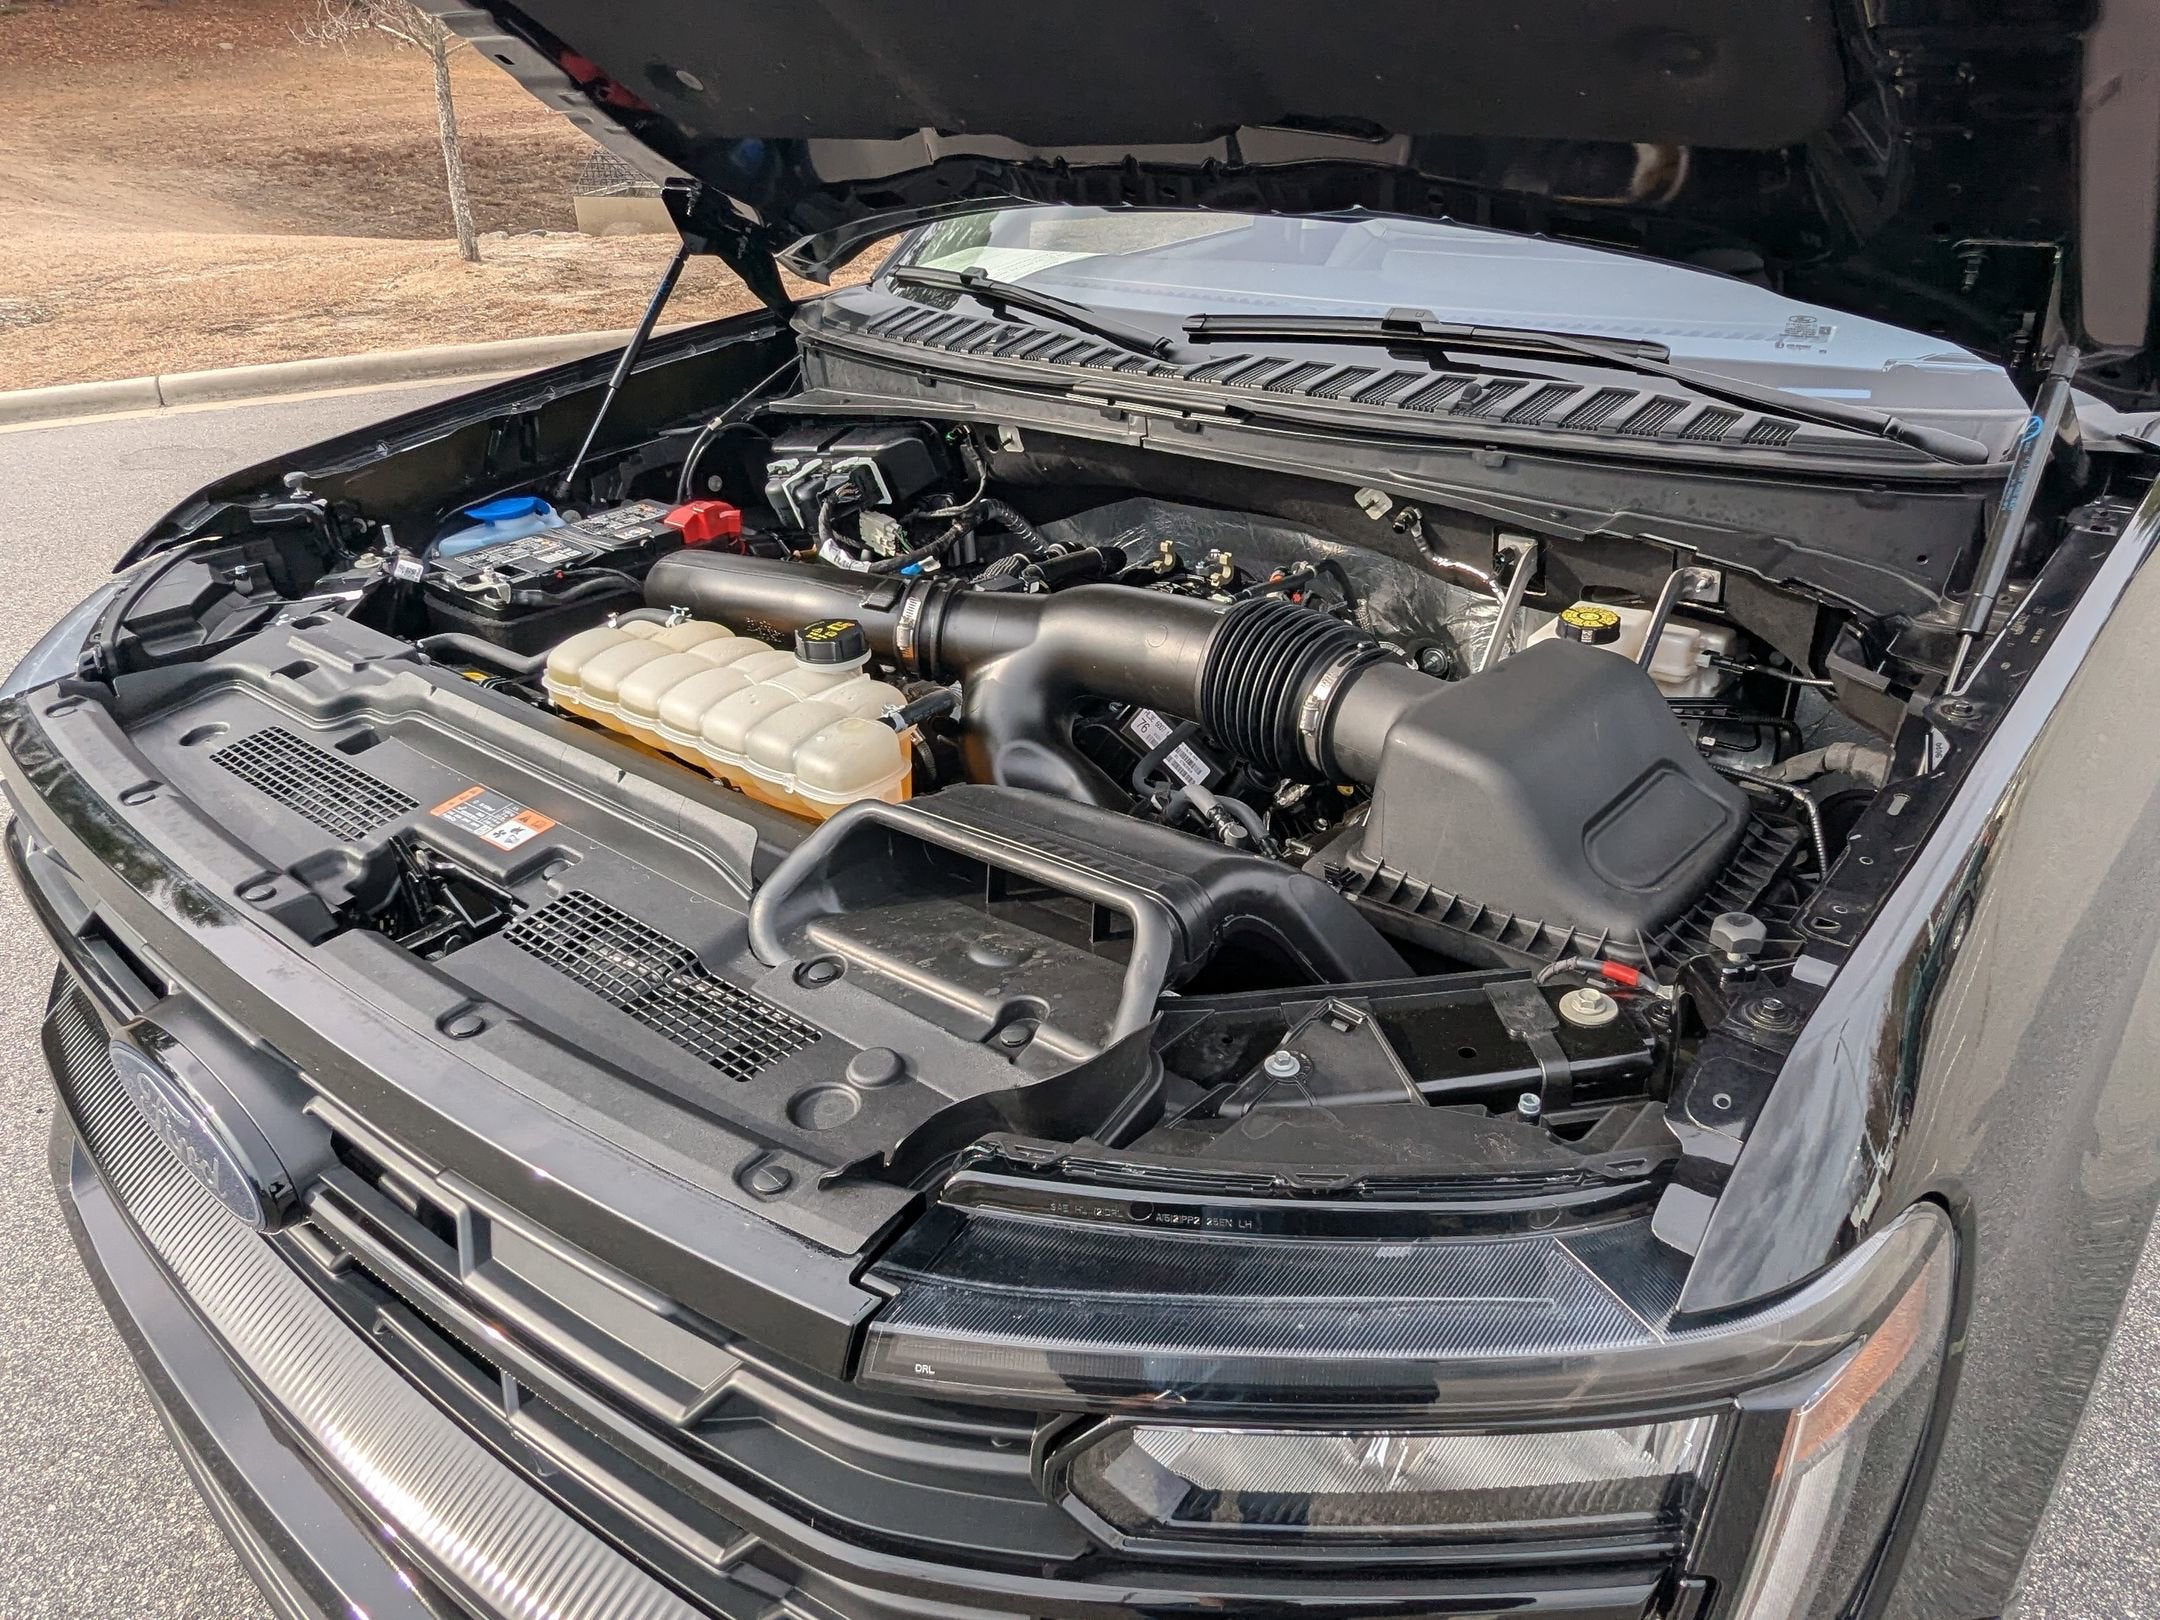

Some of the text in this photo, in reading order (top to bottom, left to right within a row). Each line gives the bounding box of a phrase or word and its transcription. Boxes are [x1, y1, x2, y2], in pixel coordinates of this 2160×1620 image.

[1137, 717, 1151, 734] 76
[1050, 1203, 1069, 1214] SAE
[1238, 1219, 1253, 1230] LH
[914, 1362, 936, 1375] DRL
